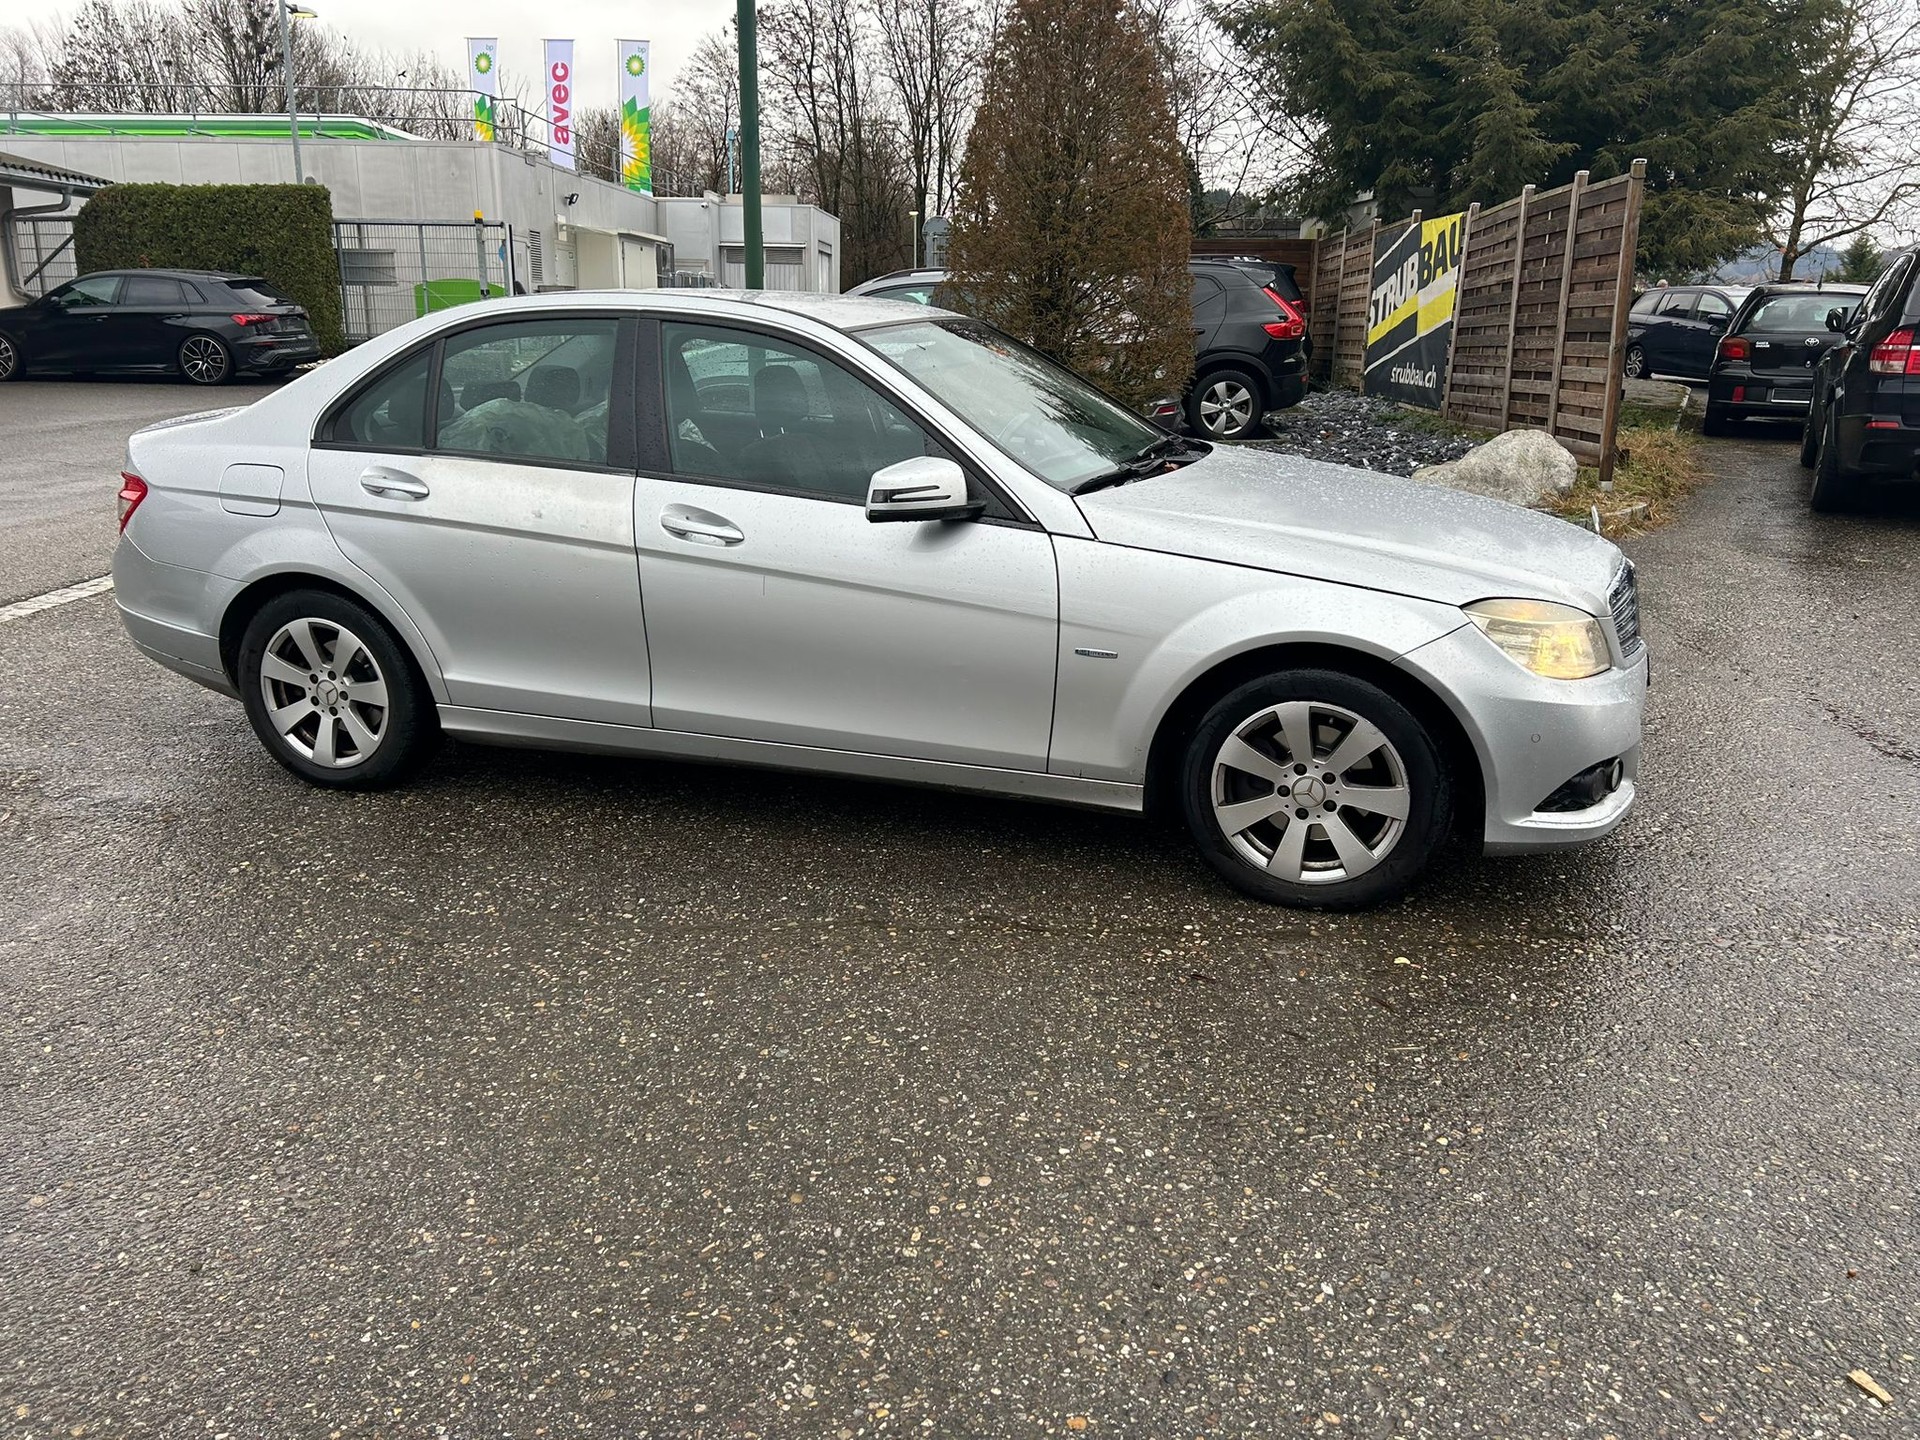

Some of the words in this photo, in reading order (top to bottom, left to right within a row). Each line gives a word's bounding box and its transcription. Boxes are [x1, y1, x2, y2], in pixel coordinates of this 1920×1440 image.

[485, 44, 494, 52] bp
[637, 46, 647, 54] bp
[551, 61, 570, 145] avec
